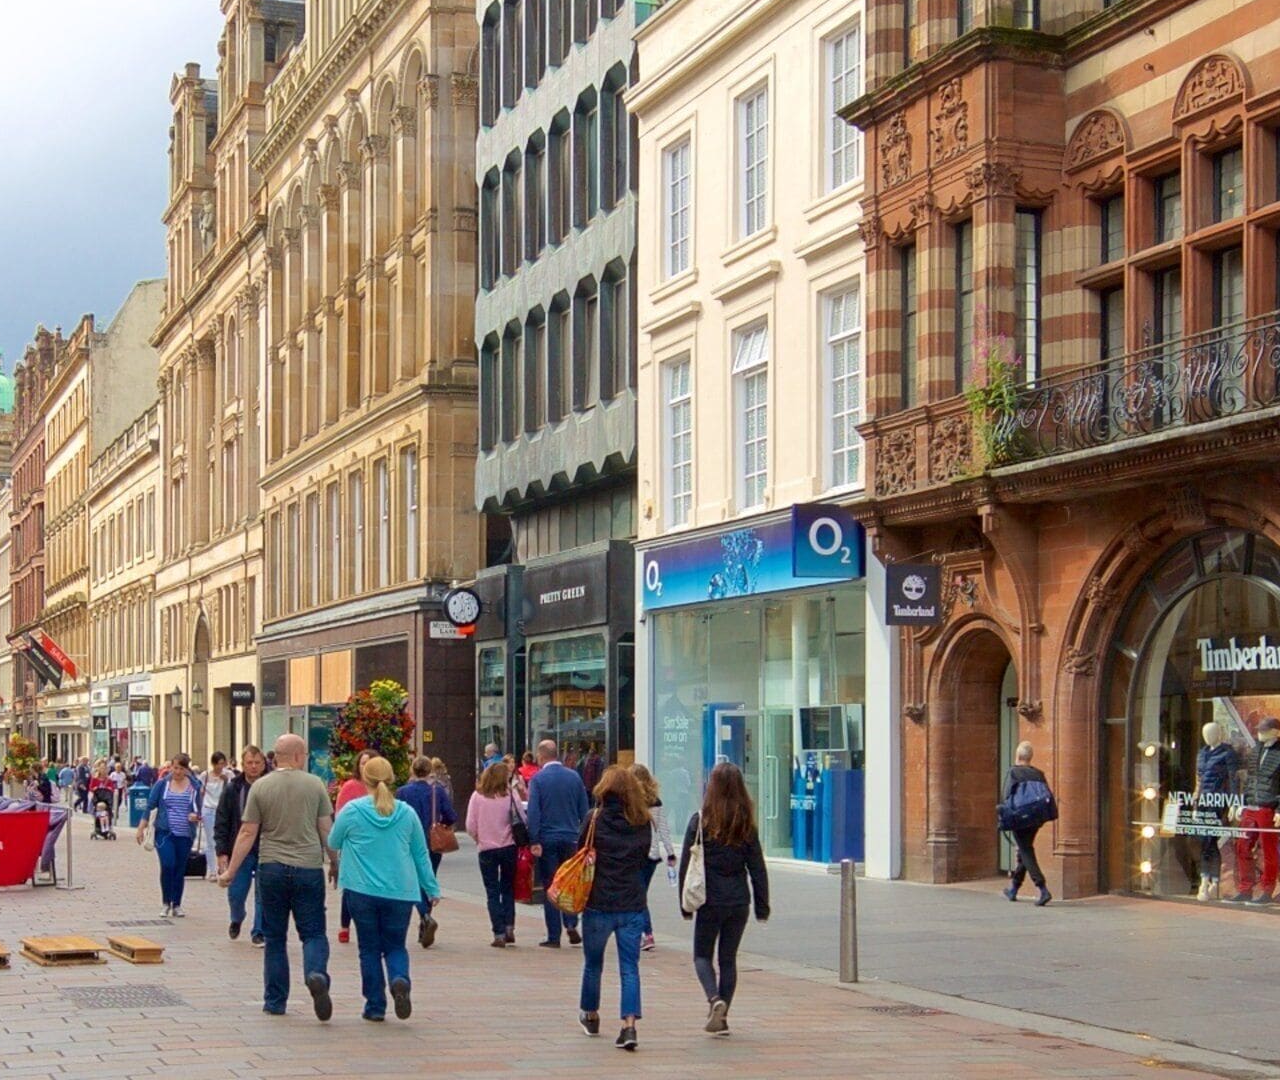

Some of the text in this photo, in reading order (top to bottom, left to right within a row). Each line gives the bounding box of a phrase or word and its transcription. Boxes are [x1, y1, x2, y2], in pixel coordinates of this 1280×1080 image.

[540, 585, 585, 604] PRETTY GREEN
[893, 605, 935, 617] Timberland
[1168, 791, 1194, 806] NEW
